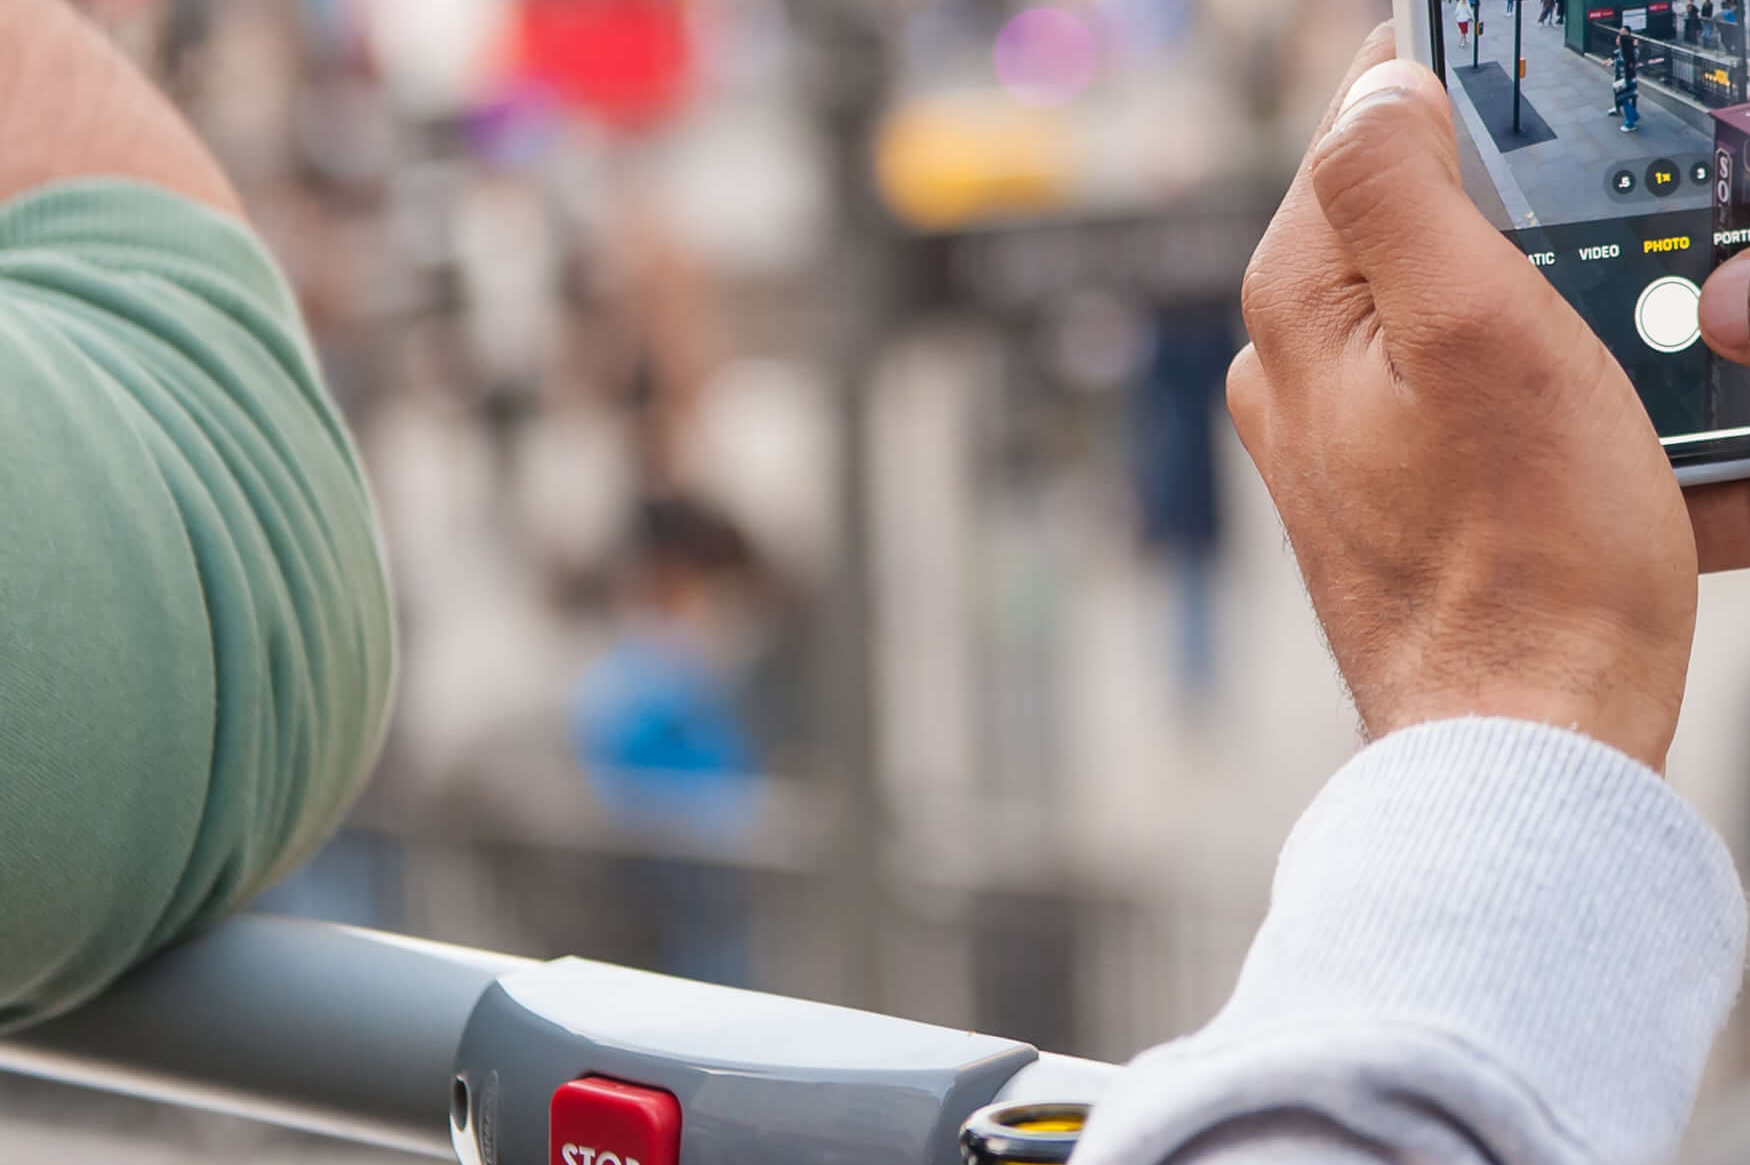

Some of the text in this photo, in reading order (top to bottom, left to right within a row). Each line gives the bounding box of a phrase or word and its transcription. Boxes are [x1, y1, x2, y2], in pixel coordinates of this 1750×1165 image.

[1618, 176, 1631, 188] .5
[1696, 167, 1706, 179] 3
[1578, 244, 1620, 260] VIDEO
[1643, 236, 1690, 253] PHOTO
